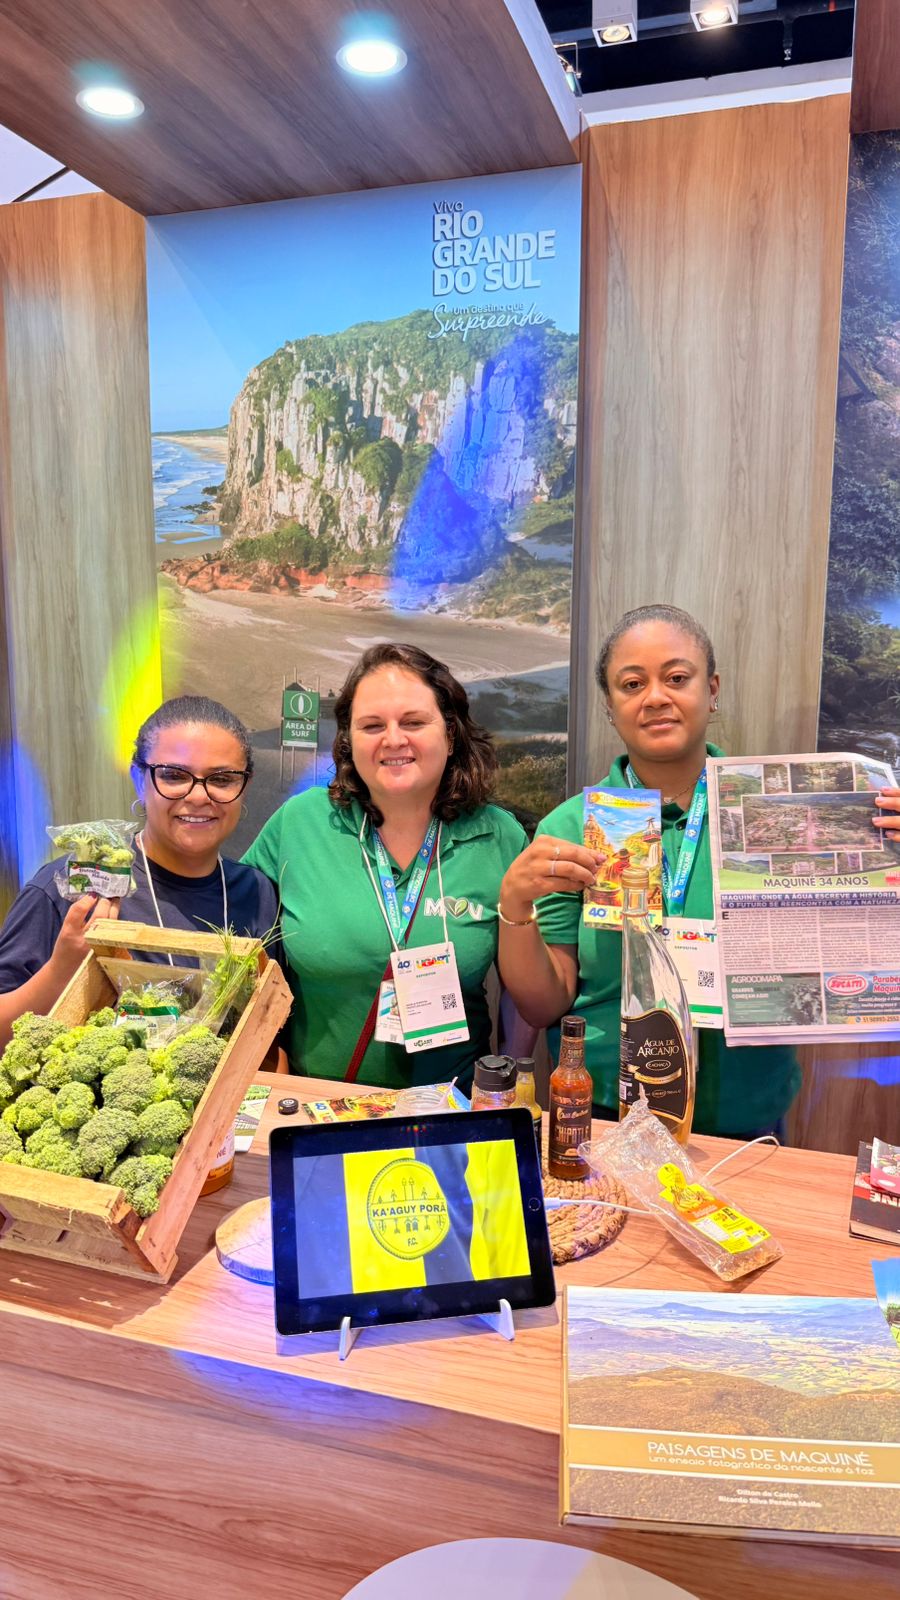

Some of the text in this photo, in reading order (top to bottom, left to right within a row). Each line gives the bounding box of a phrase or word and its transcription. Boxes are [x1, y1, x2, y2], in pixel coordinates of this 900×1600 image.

[433, 200, 464, 214] Viva
[433, 210, 484, 242] RIO
[432, 229, 556, 269] GRANDE
[433, 259, 541, 297] DO SUL
[471, 304, 504, 314] destino
[507, 303, 525, 313] que
[427, 302, 547, 341] Surpreende
[306, 723, 316, 731] DE
[819, 877, 833, 886] 34
[835, 876, 869, 886] ANOS
[637, 1046, 680, 1058] ARCANJO
[647, 1441, 873, 1467] PAISAGENS DE MAQUINÉ
[668, 1457, 705, 1466] ensaio
[791, 1465, 843, 1474] nascente
[774, 1491, 799, 1499] Castro
